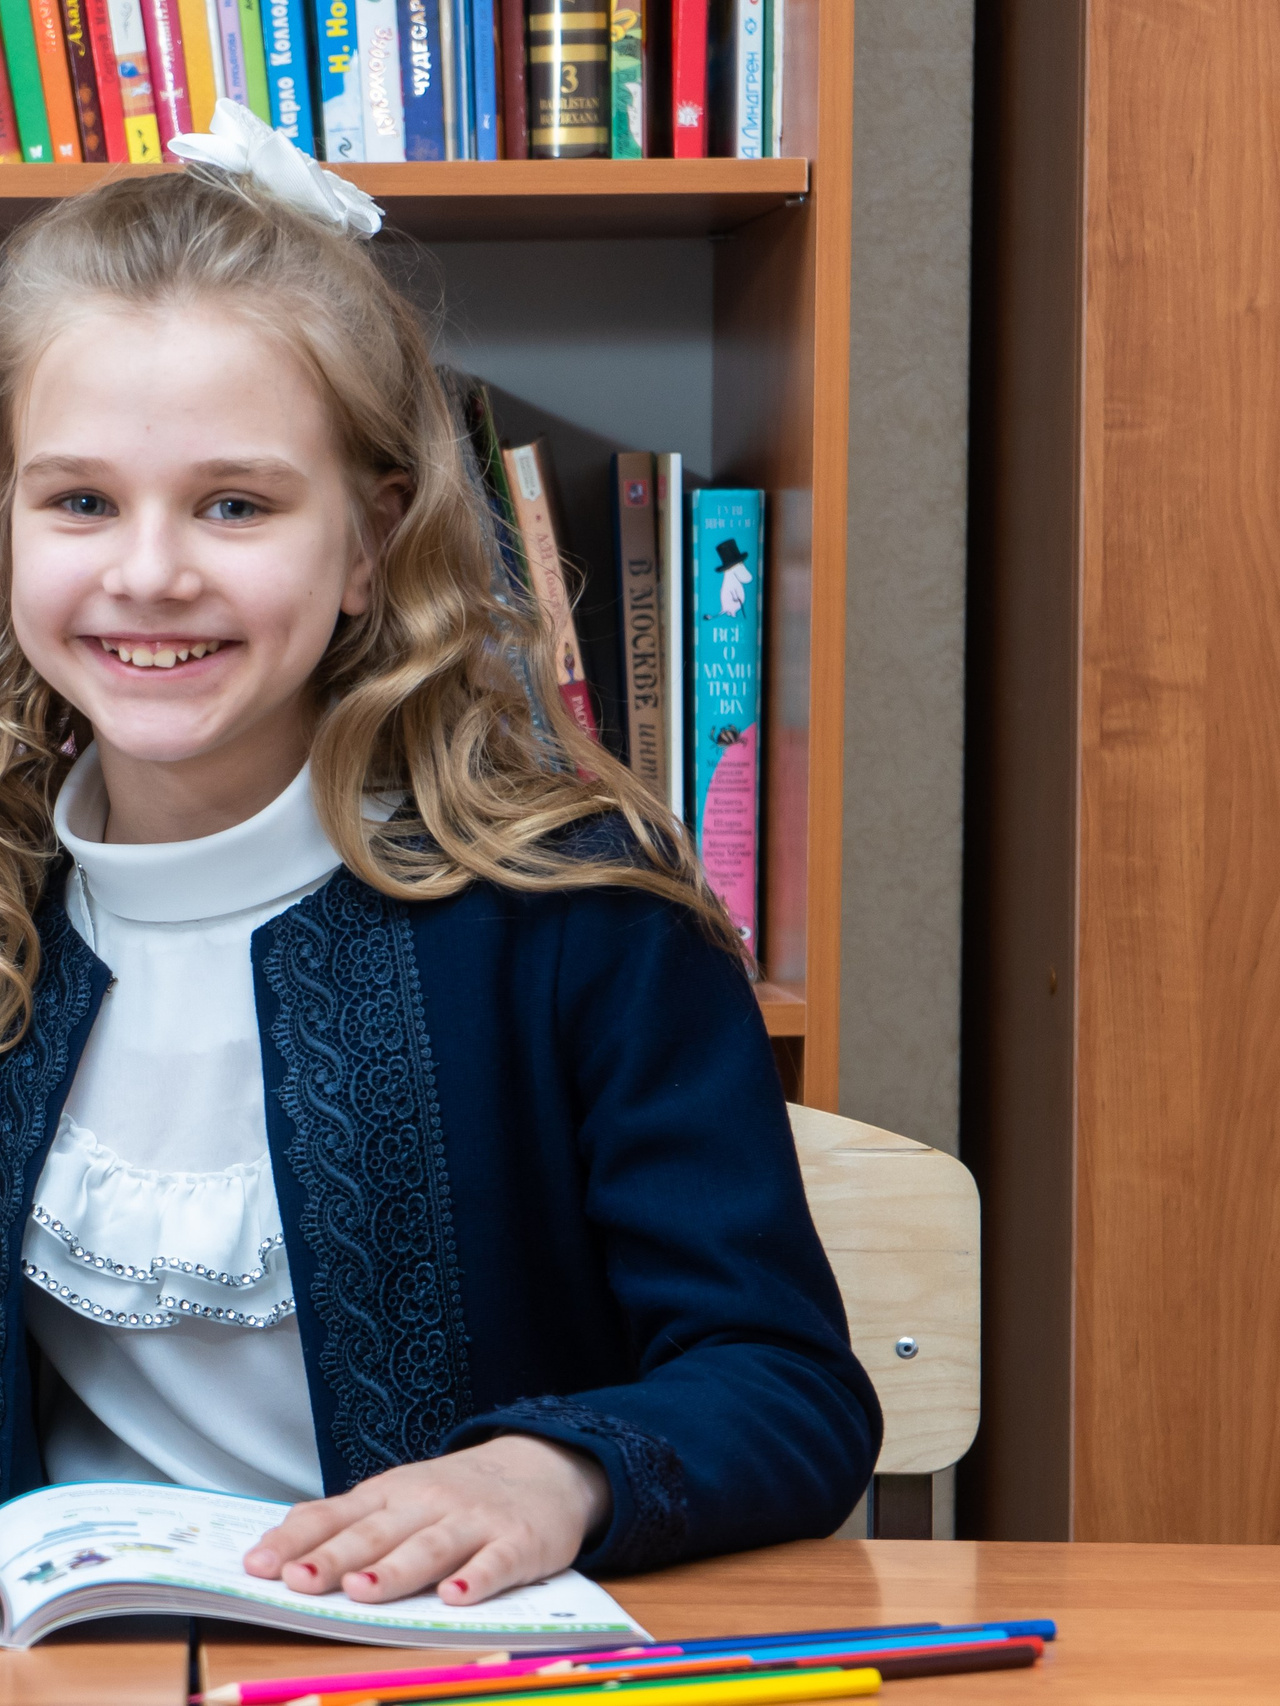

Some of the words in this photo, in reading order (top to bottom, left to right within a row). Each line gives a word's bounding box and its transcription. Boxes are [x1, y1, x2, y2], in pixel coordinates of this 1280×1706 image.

[327, 45, 351, 74] Н.
[560, 64, 579, 94] 3
[276, 76, 302, 138] Карло
[740, 51, 760, 139] Линдгрен
[628, 558, 652, 576] В
[629, 586, 658, 711] МОСКВЕ
